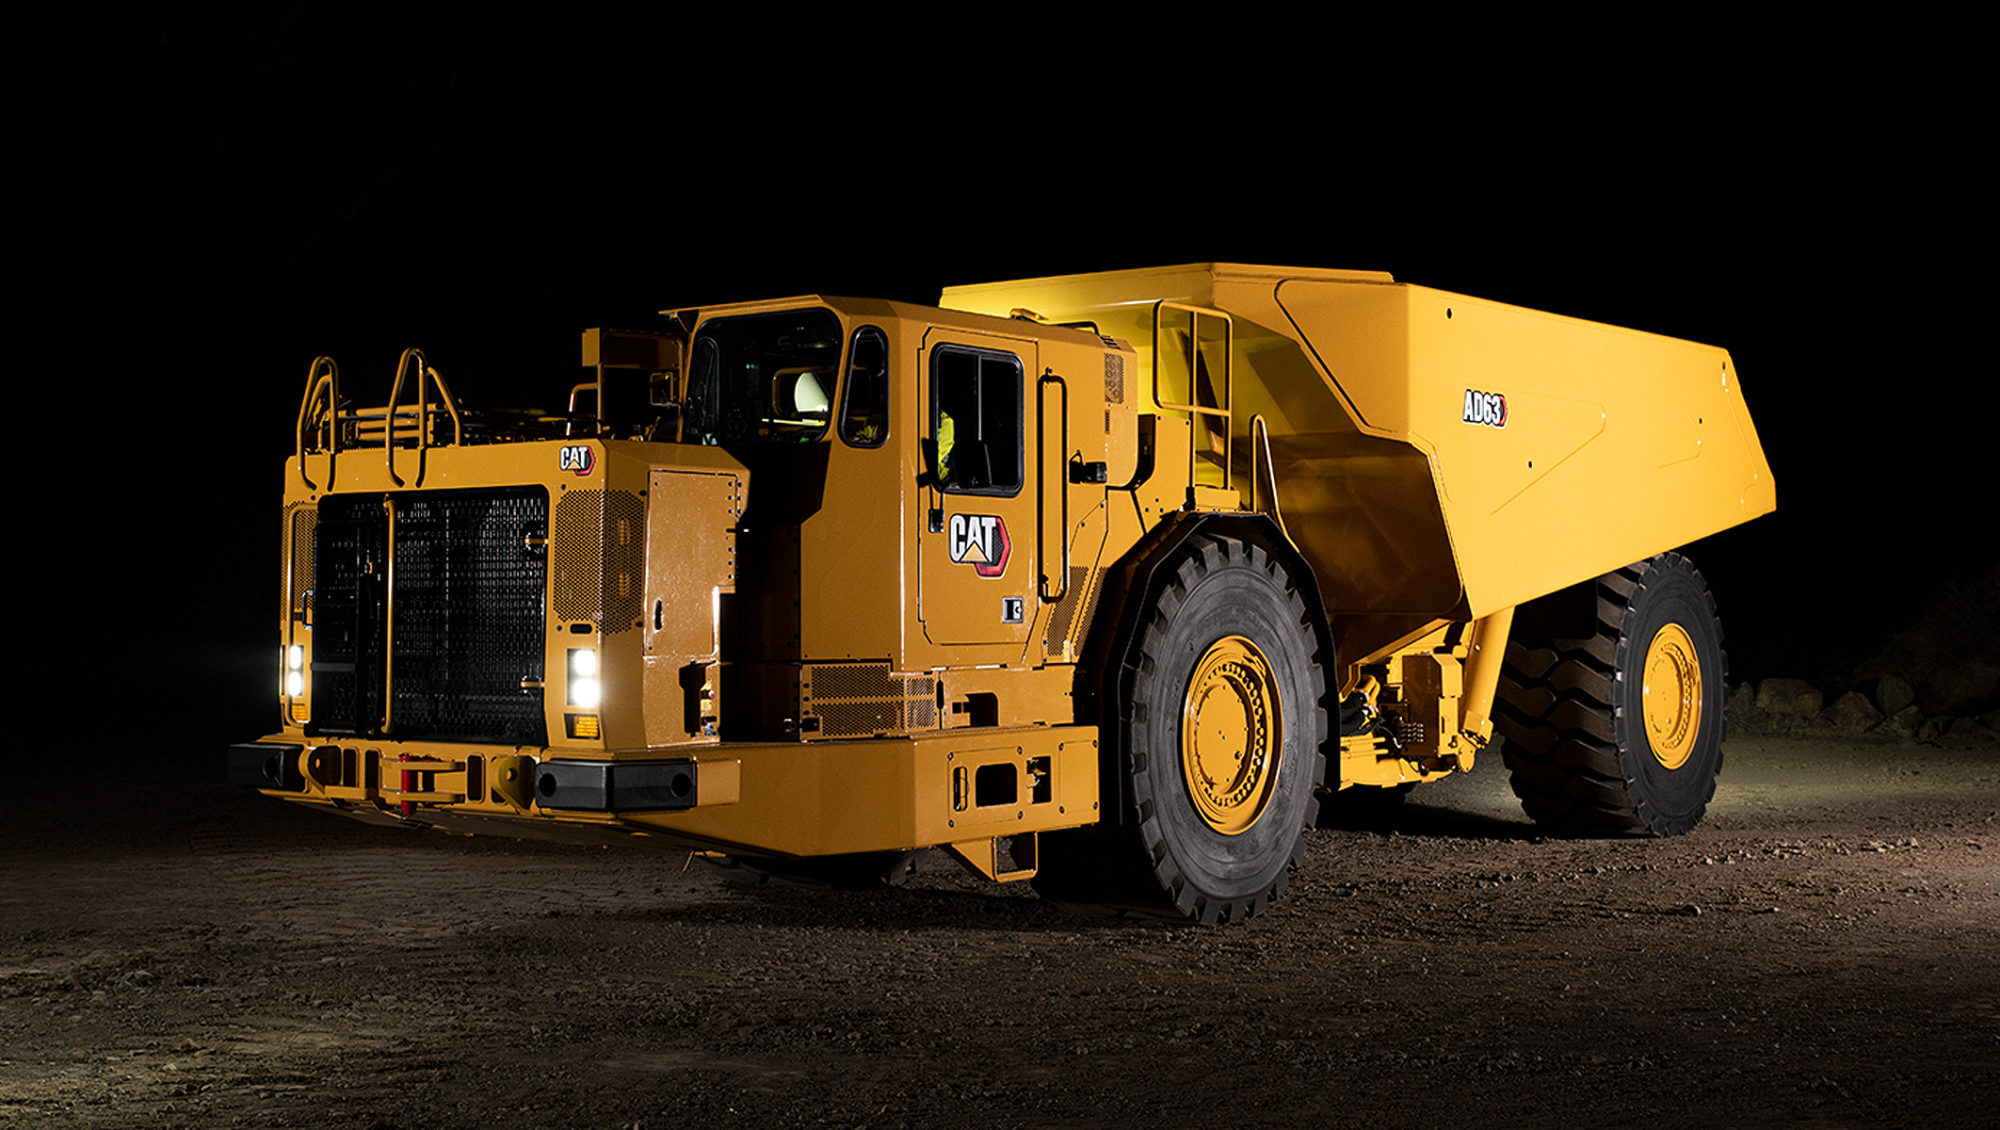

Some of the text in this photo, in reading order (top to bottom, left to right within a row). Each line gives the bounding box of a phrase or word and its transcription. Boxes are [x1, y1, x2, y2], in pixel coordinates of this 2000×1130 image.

[1463, 389, 1501, 425] AD63
[560, 446, 588, 470] CAT
[950, 515, 996, 562] CAT
